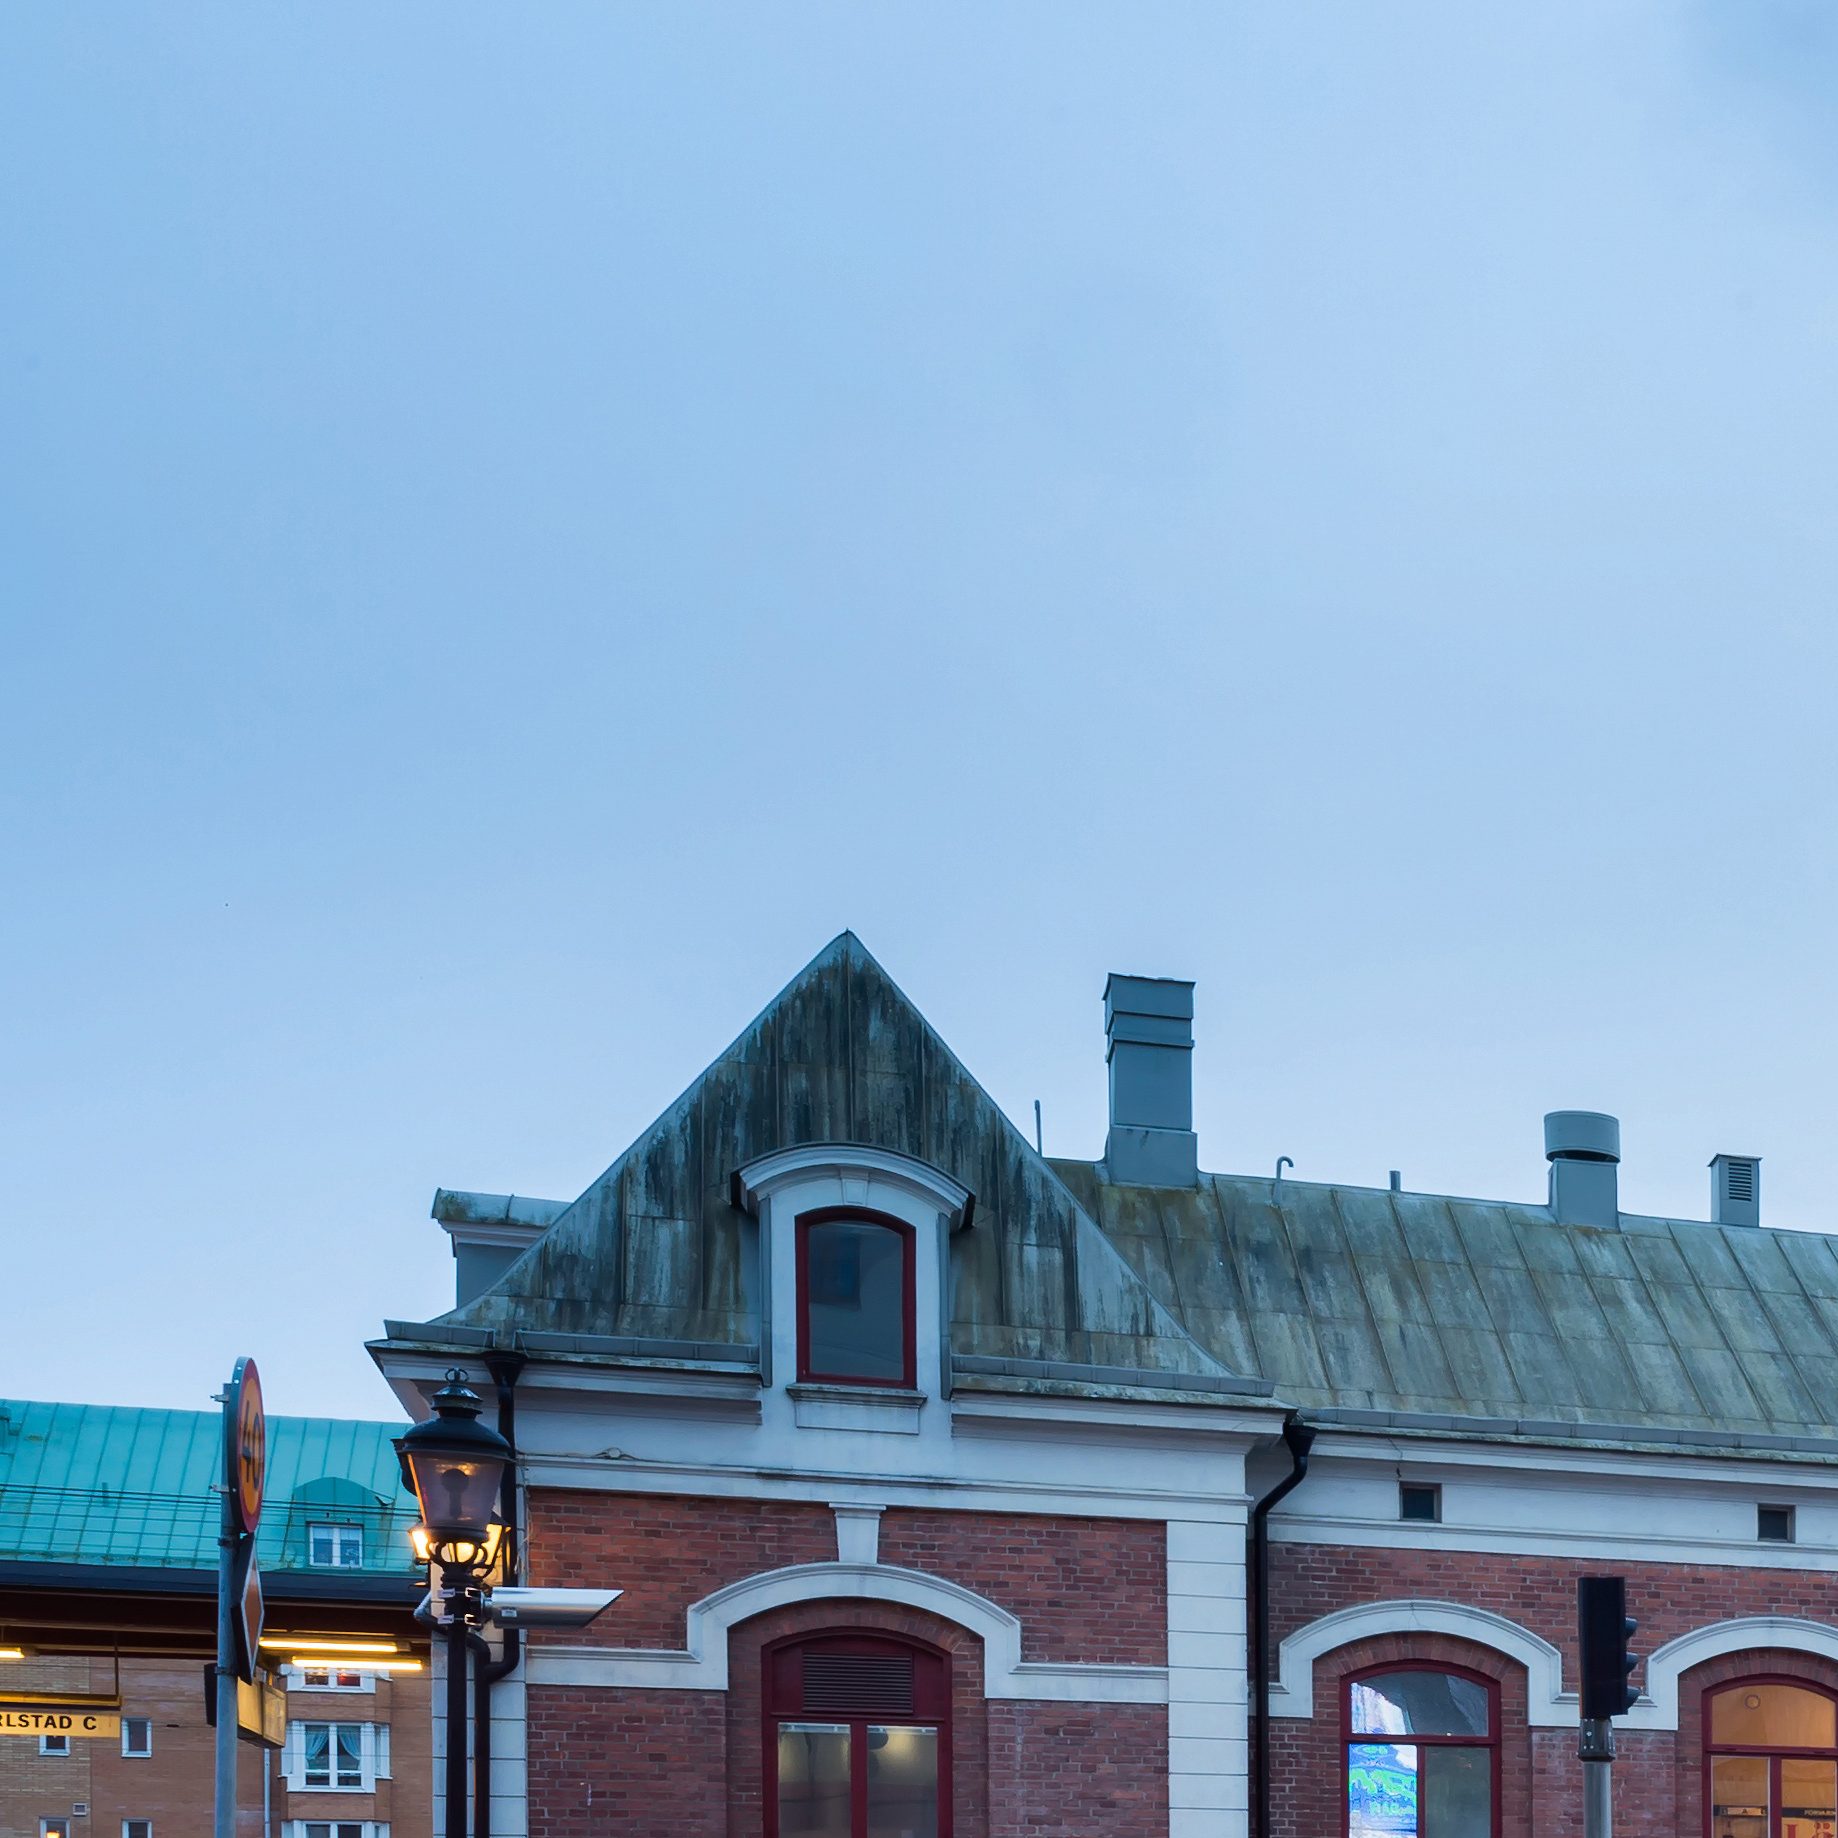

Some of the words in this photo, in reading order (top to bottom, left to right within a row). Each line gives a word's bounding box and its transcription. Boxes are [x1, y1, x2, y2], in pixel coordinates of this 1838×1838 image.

[241, 1398, 261, 1490] 40
[0, 1714, 73, 1730] LSTAD
[83, 1716, 97, 1730] C
